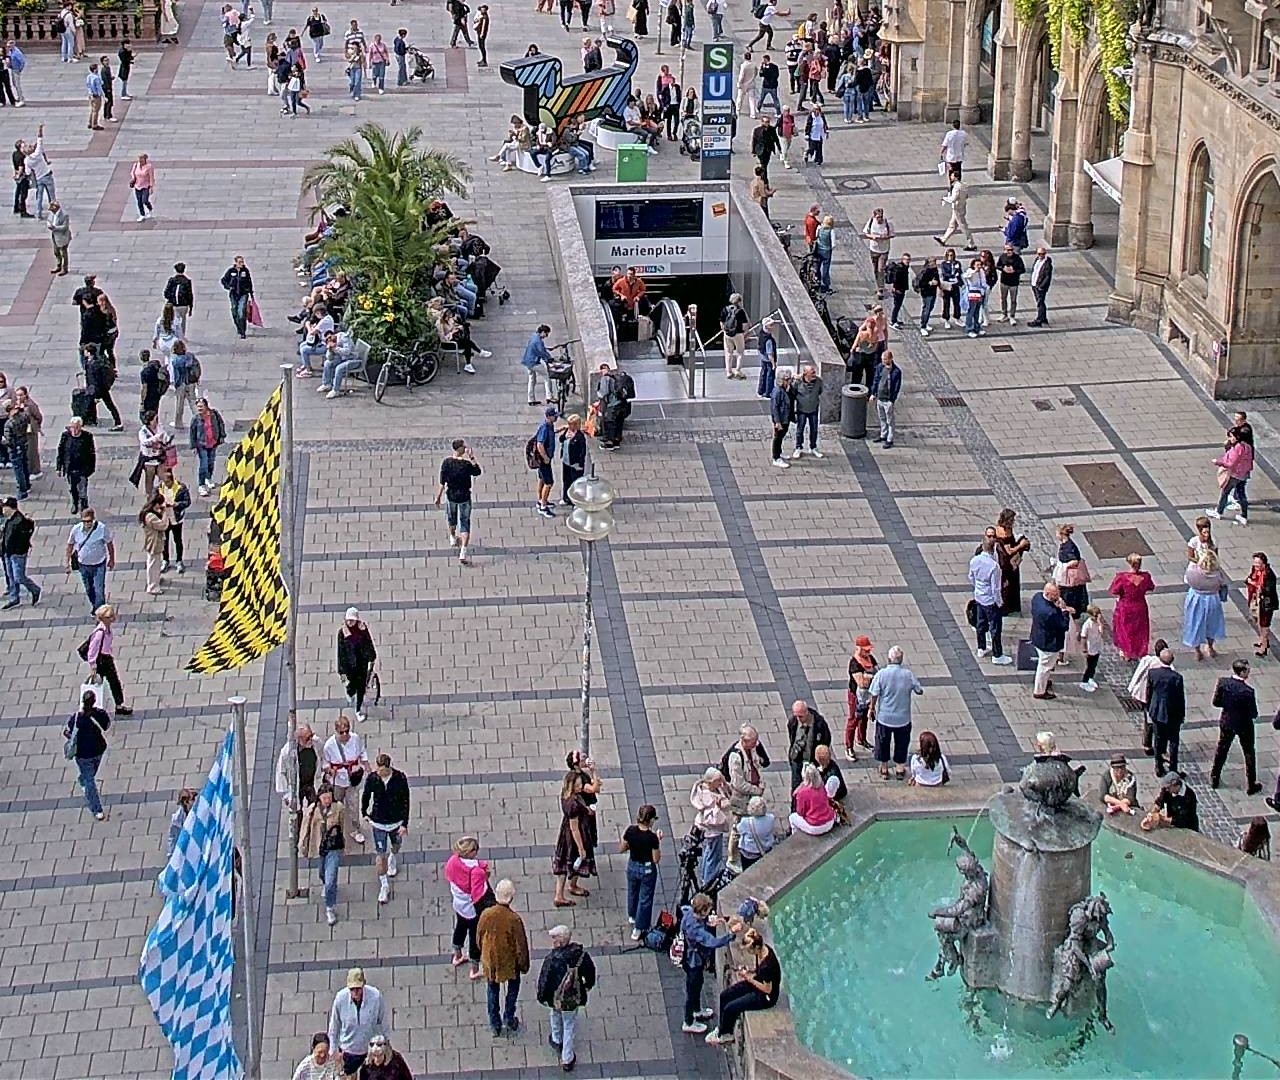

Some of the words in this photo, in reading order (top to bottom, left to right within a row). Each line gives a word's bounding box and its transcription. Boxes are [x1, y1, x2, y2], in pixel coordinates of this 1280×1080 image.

[709, 47, 728, 70] S
[709, 76, 726, 97] U
[611, 244, 687, 258] Marienplatz
